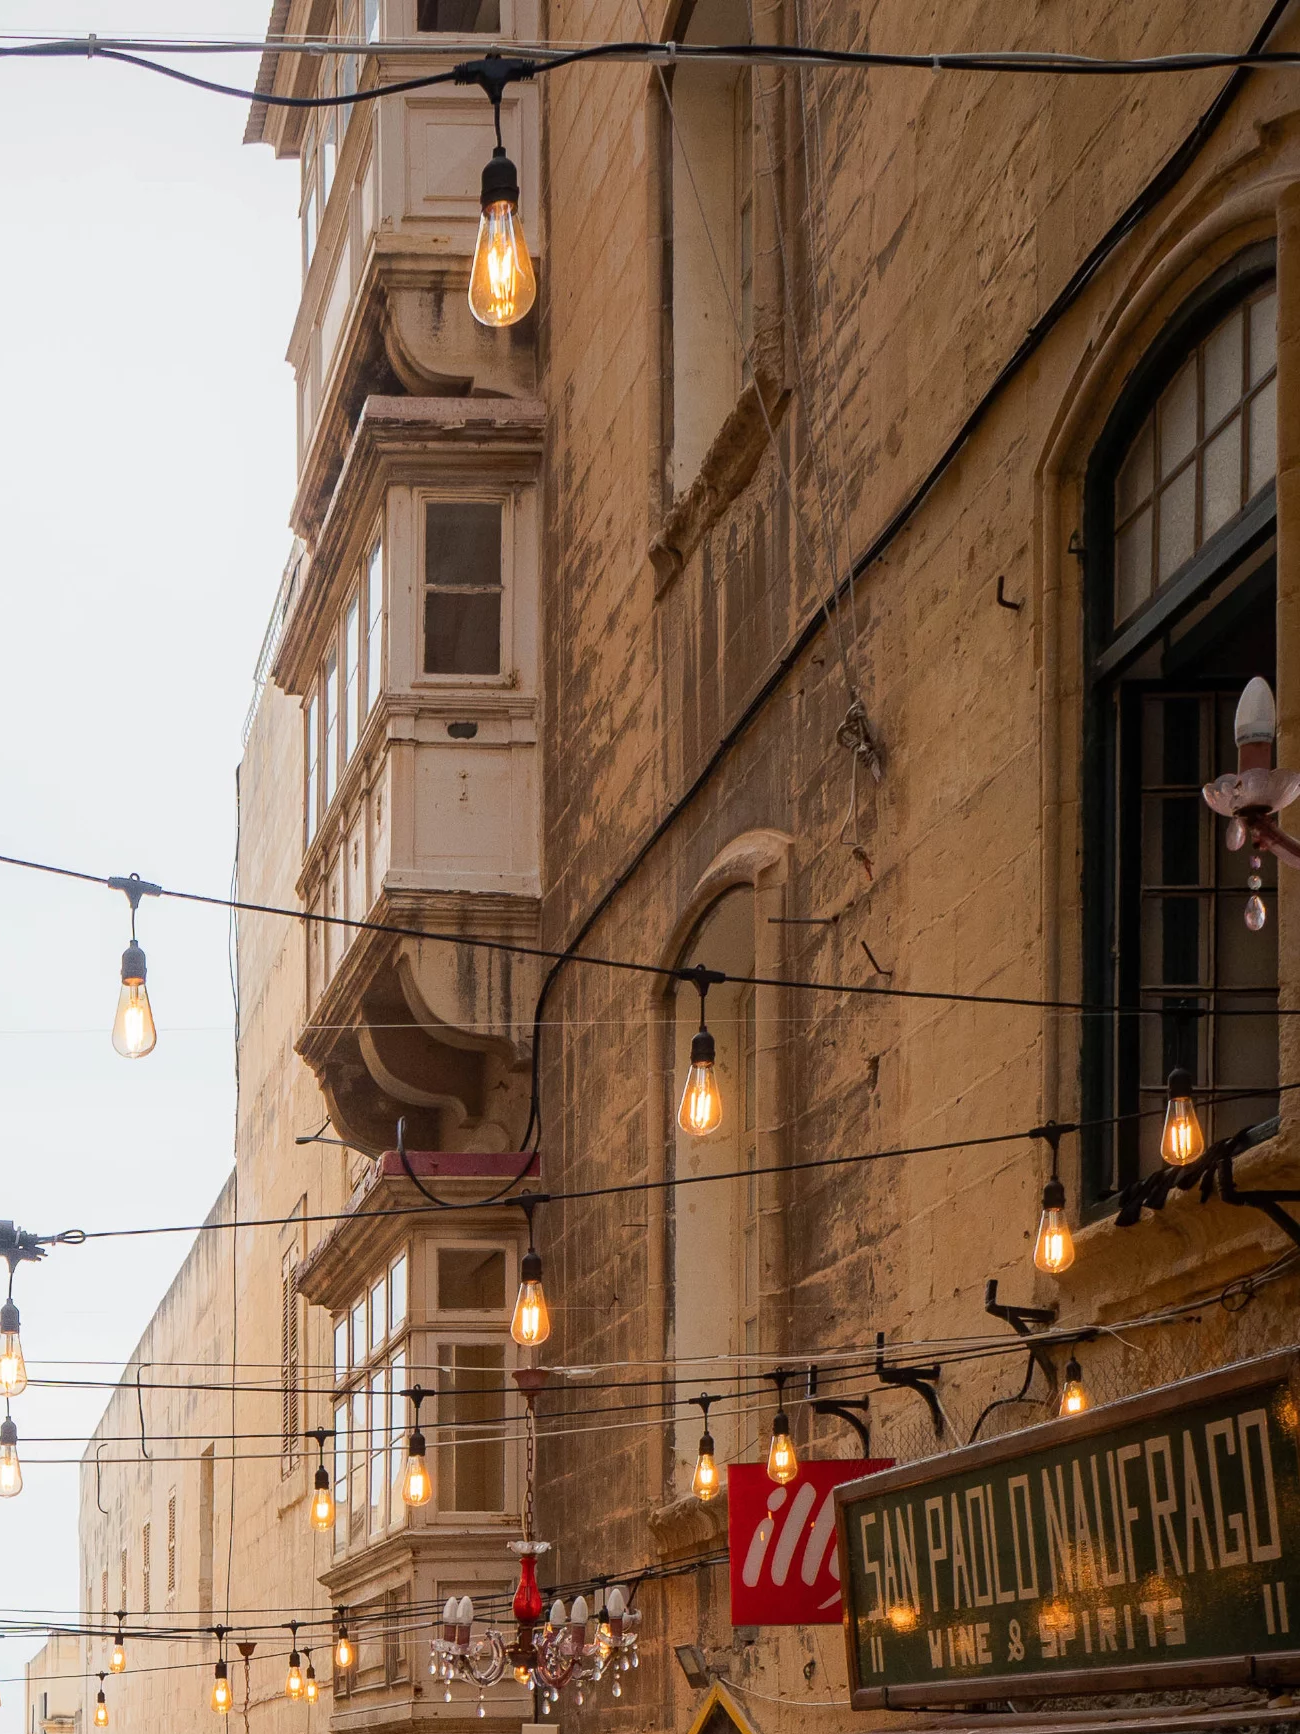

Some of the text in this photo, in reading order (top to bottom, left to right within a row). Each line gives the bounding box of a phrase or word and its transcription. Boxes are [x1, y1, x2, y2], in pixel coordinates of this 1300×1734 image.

[859, 1408, 1283, 1620] SAN PAOLO NAUFRAGO
[928, 1622, 994, 1670] WINE
[1006, 1623, 1026, 1663] &
[1038, 1596, 1187, 1659] SPIRITS
